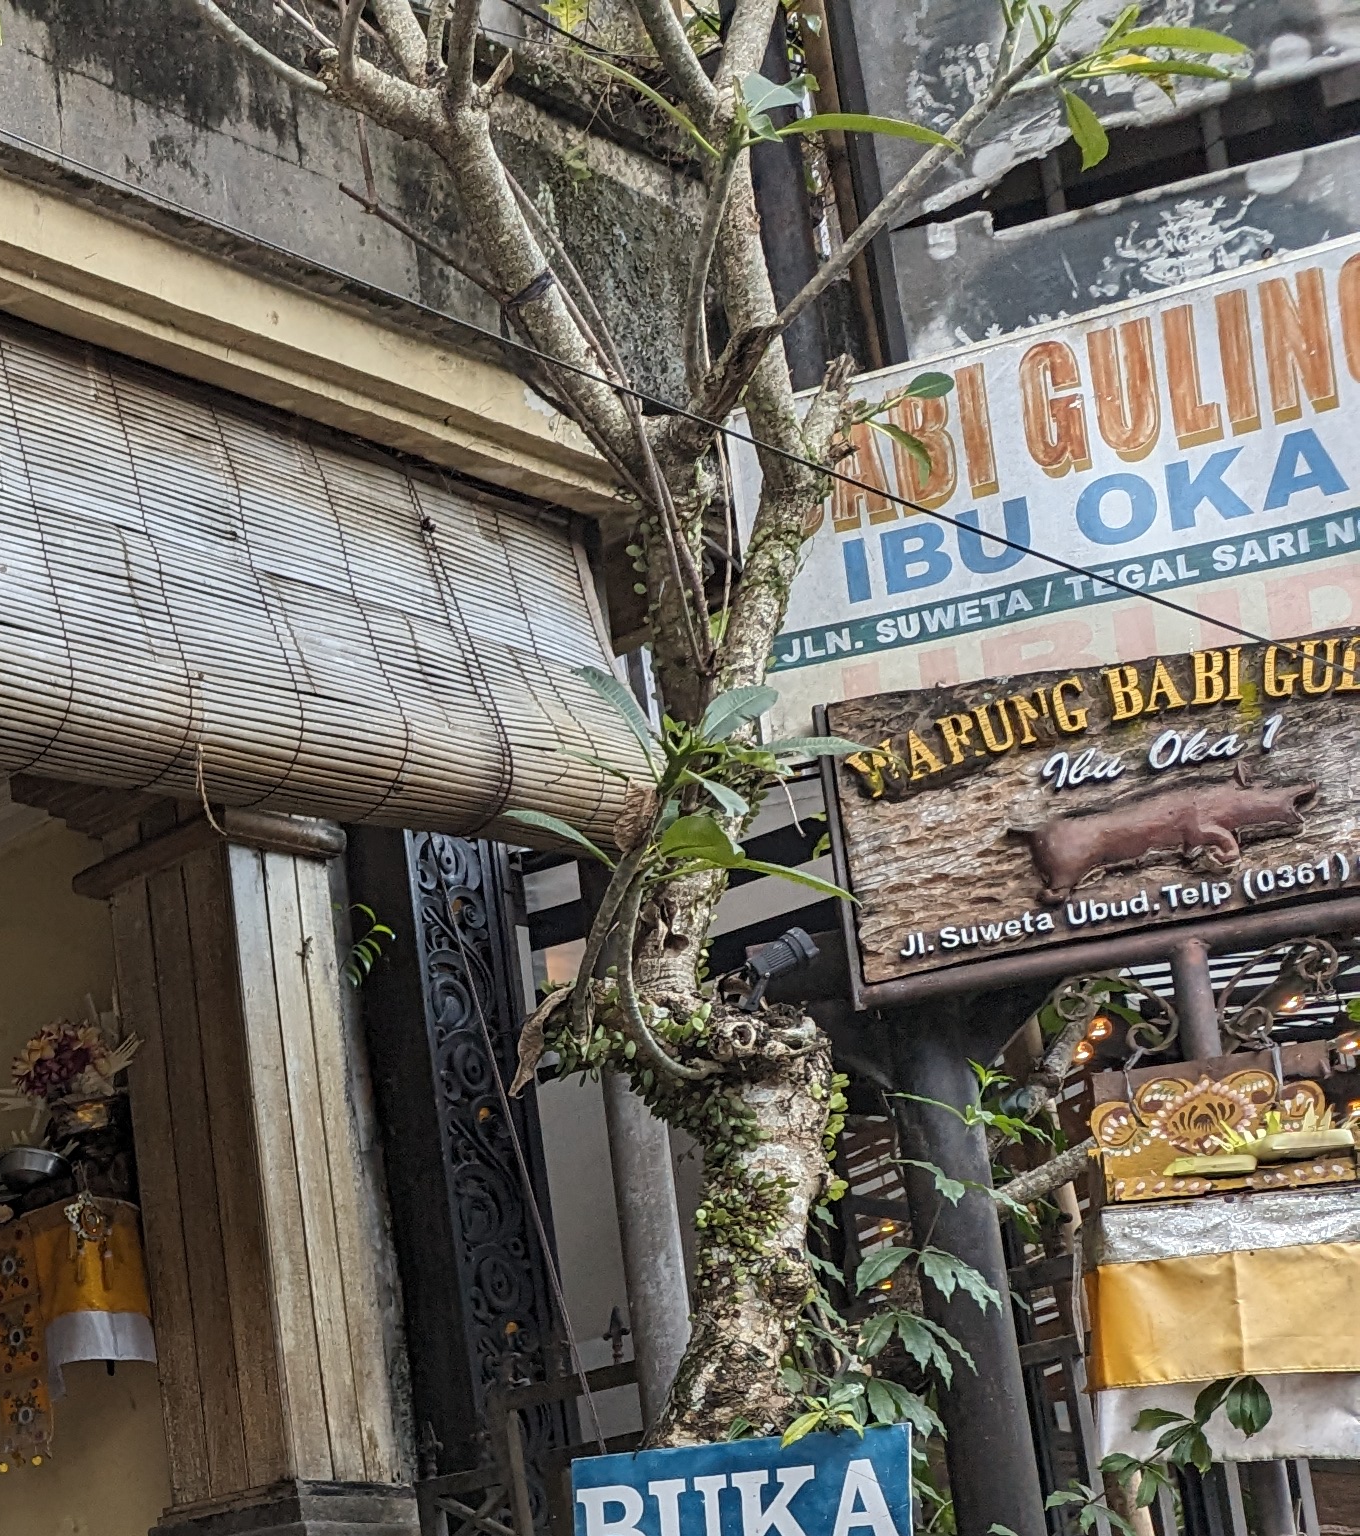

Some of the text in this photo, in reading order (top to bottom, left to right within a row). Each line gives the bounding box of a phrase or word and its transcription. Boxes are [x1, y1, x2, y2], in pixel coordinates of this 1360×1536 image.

[803, 362, 999, 537] ABI
[842, 427, 1349, 603] IBU OKA
[781, 627, 864, 664] JLN.
[876, 589, 1034, 643] SUWETA
[1066, 556, 1201, 601] TEGAL
[1212, 529, 1310, 572] SARI
[1325, 517, 1360, 548] N
[846, 677, 1088, 796] WARUNG
[1042, 715, 1284, 789] Ibu Oka 1
[900, 933, 936, 958] Jl.
[940, 914, 1054, 950] Suweta
[1243, 853, 1350, 900] (0361)
